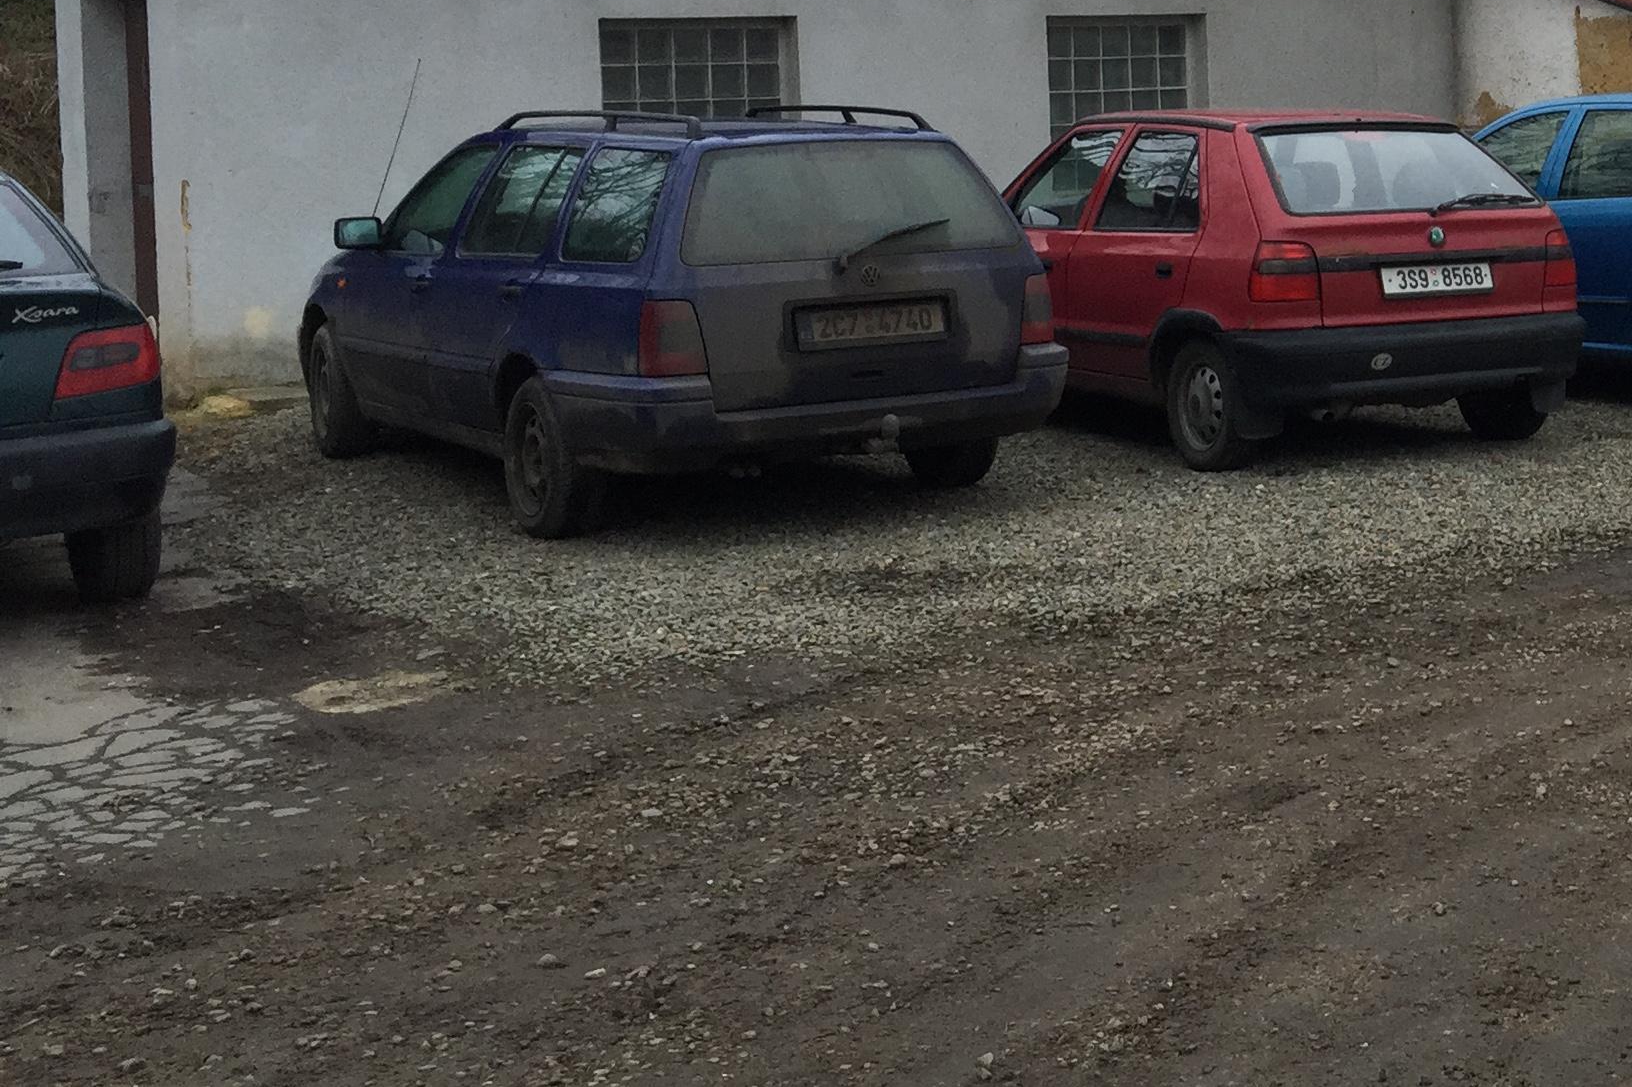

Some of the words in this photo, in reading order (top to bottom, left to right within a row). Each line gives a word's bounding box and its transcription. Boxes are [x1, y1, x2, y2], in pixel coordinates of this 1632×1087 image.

[1396, 269, 1430, 290] 3S9
[1442, 266, 1484, 287] 8568
[11, 306, 80, 324] Xsara
[878, 305, 933, 334] 4740
